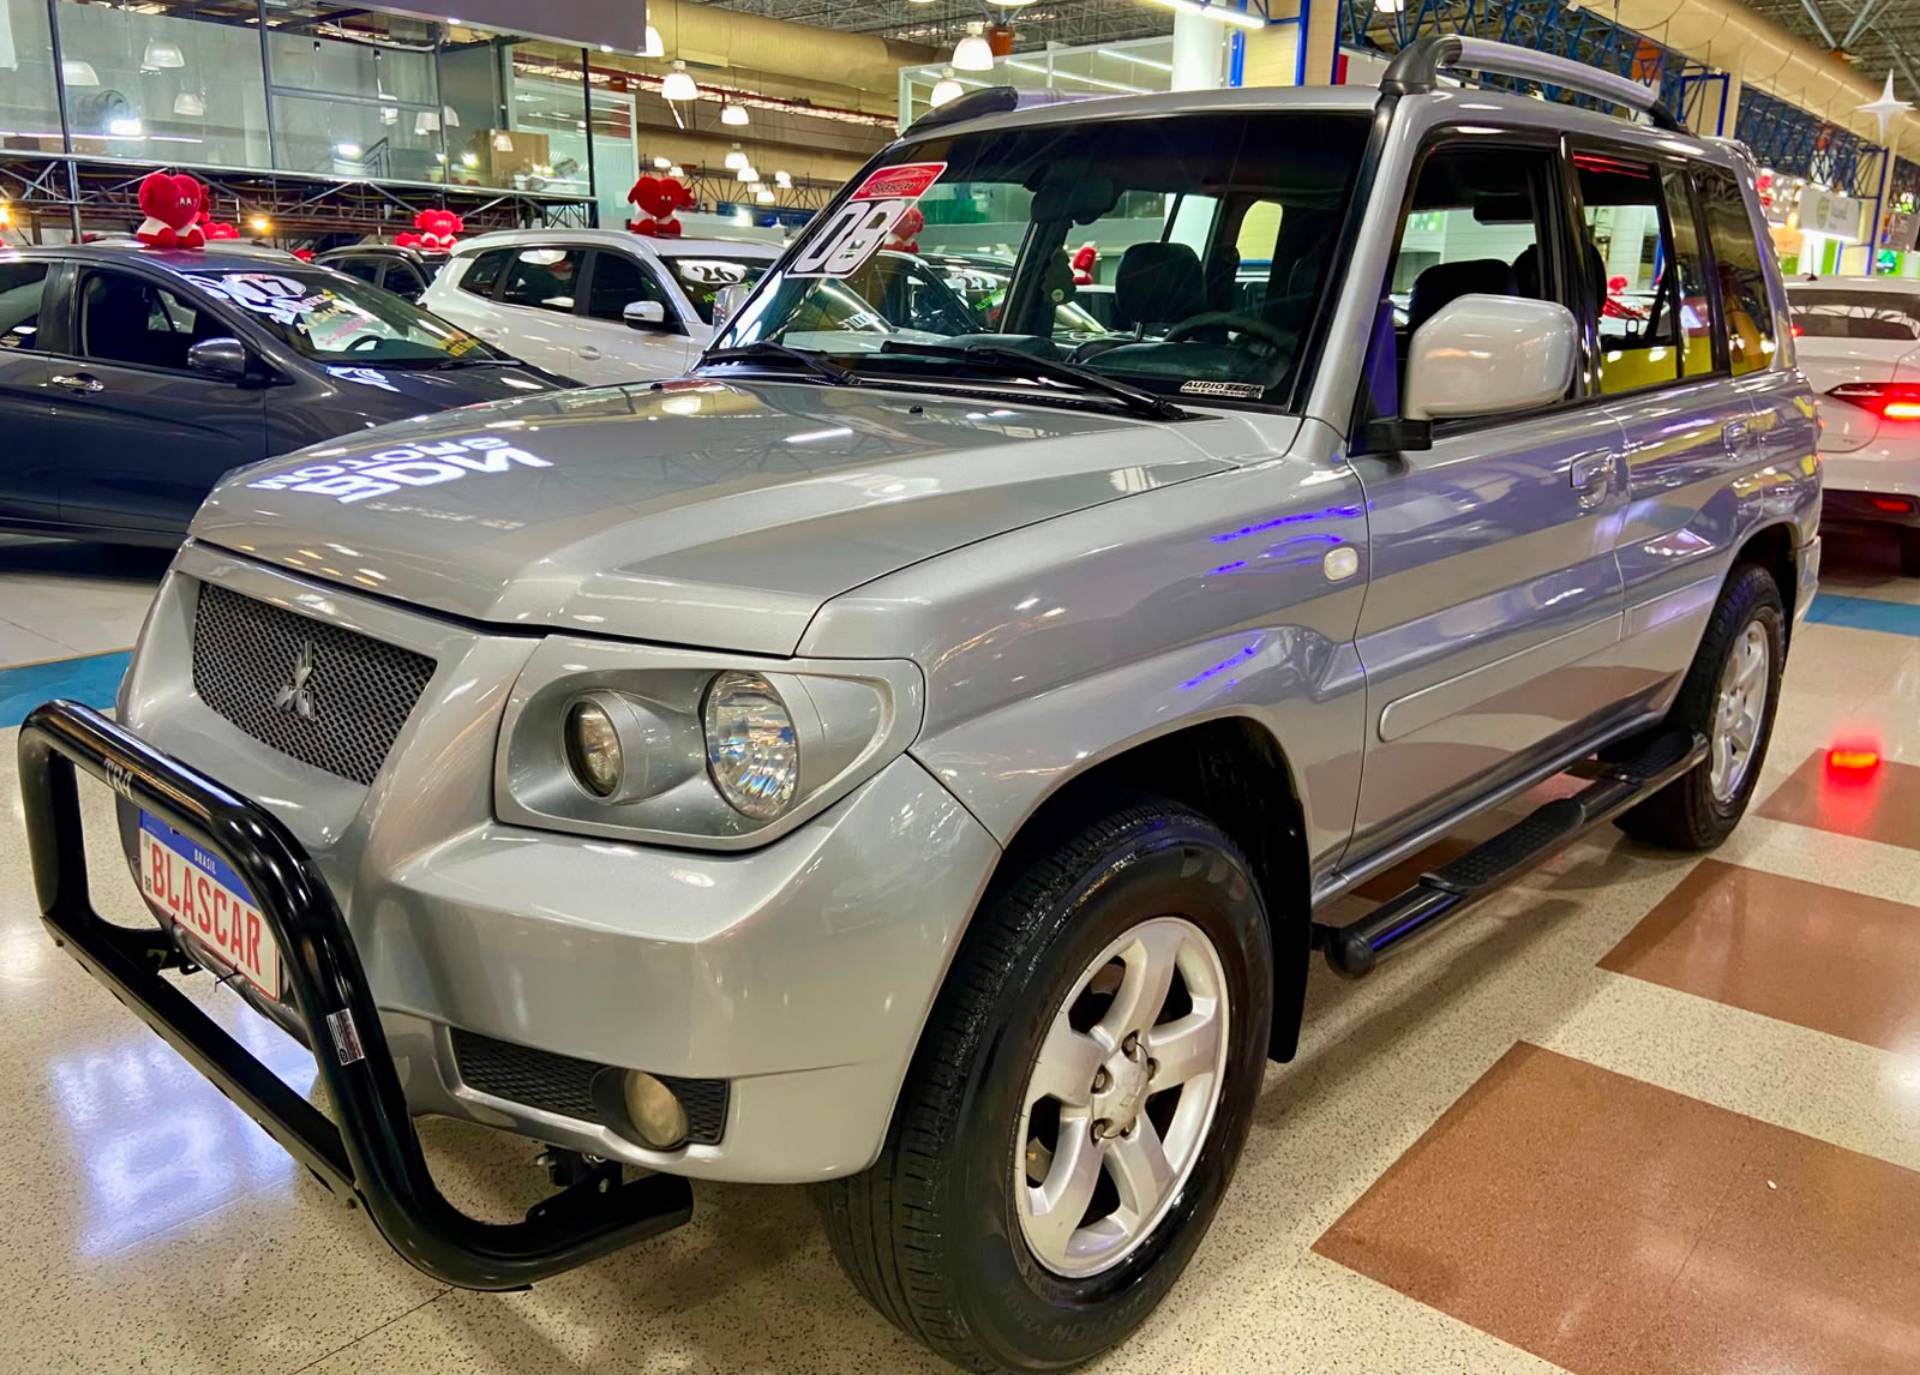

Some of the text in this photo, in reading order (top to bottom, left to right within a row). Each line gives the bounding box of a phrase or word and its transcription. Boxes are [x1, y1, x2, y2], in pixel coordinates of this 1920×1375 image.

[793, 200, 906, 273] 08
[692, 266, 739, 282] 26
[1185, 381, 1225, 390] AUDIO
[104, 757, 134, 800] TR4
[194, 848, 217, 875] BRASIL
[152, 842, 261, 976] BLASCAR
